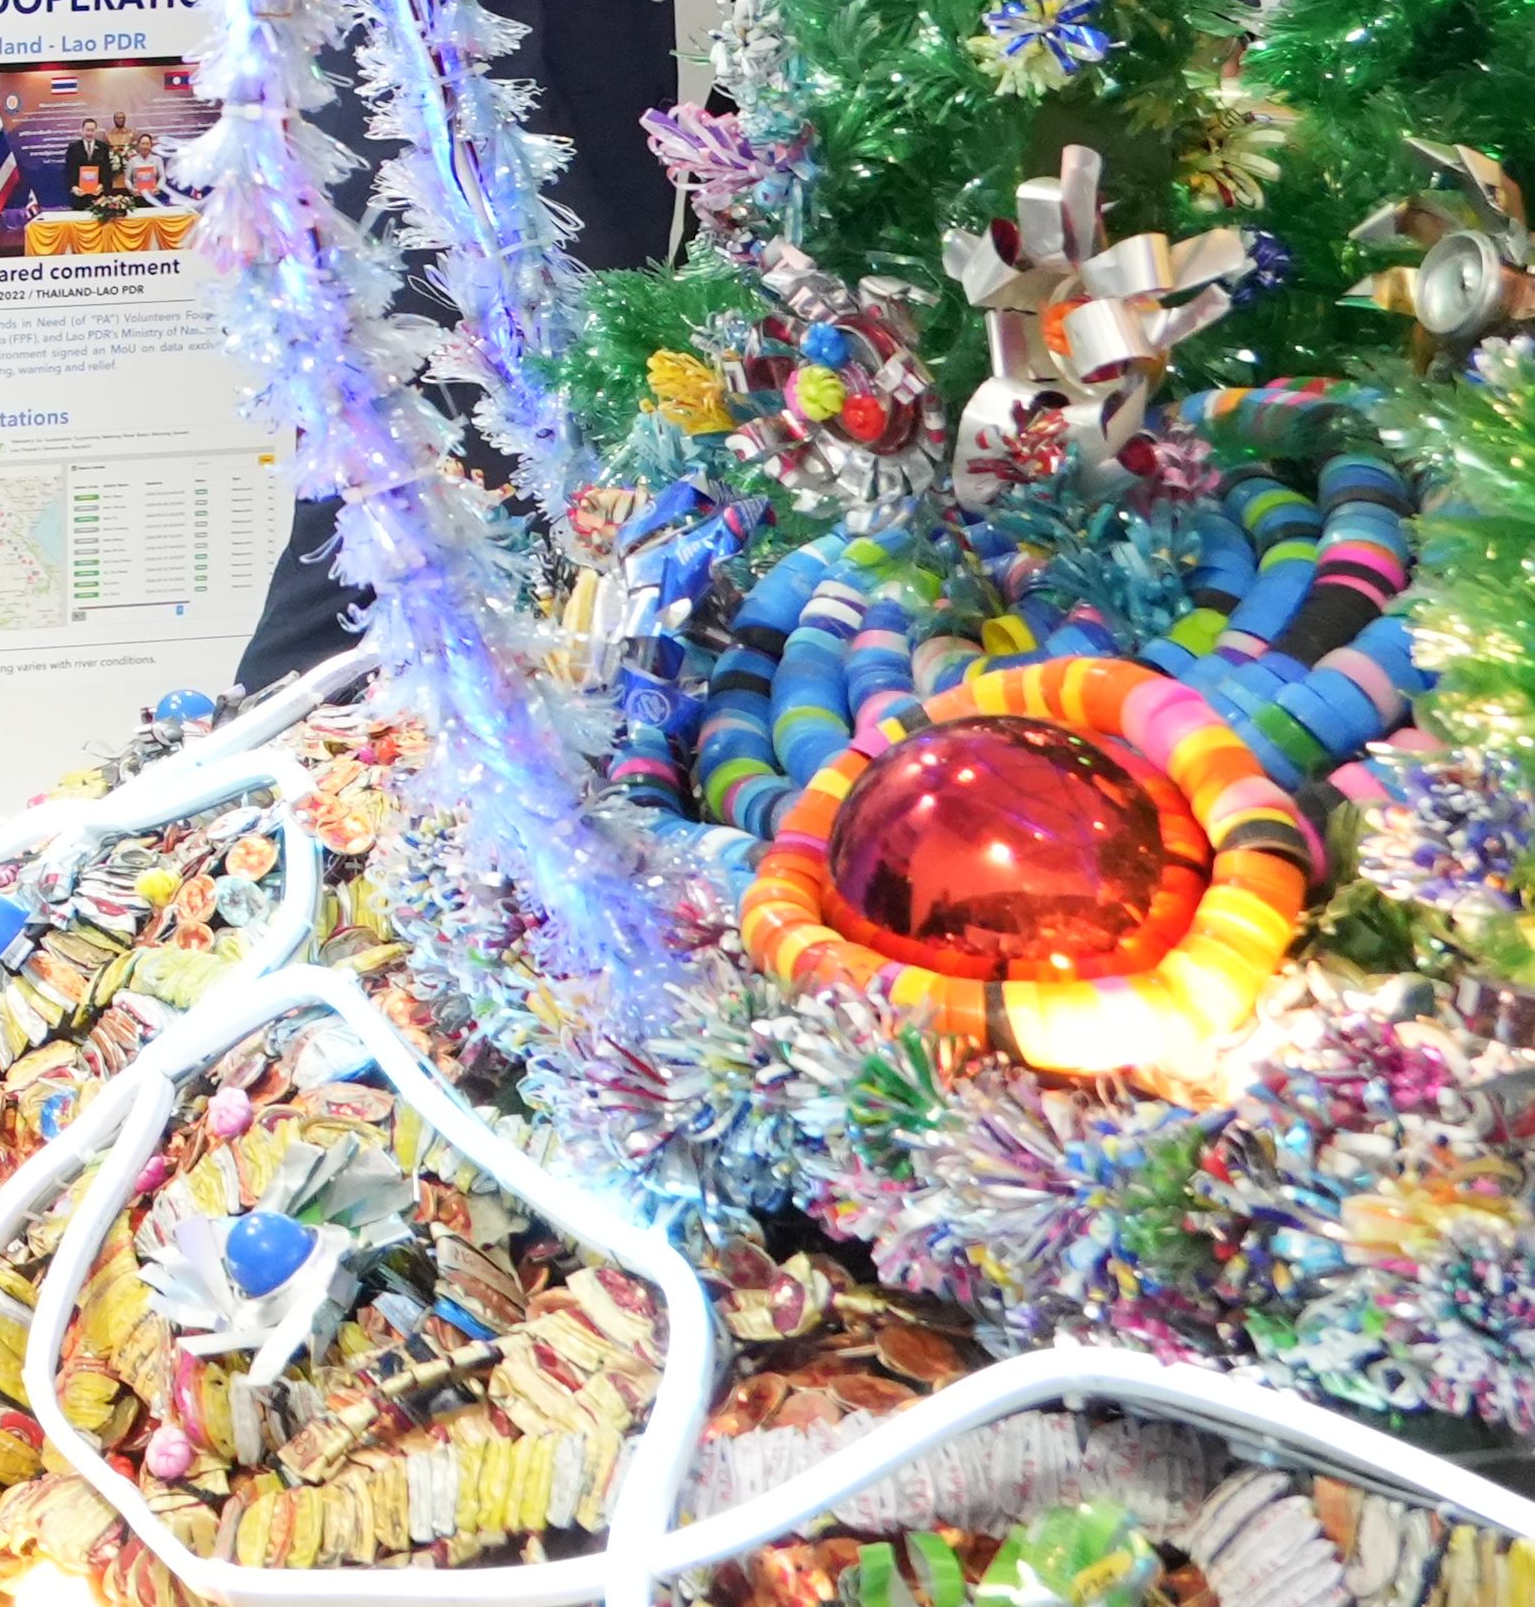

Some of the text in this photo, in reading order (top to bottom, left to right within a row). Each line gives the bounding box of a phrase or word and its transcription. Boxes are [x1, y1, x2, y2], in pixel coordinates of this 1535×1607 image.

[61, 35, 98, 53] Lao
[103, 32, 147, 51] PDR
[49, 258, 181, 281] commitment
[35, 285, 120, 299] THAILAND-LAO
[121, 284, 145, 295] PDR
